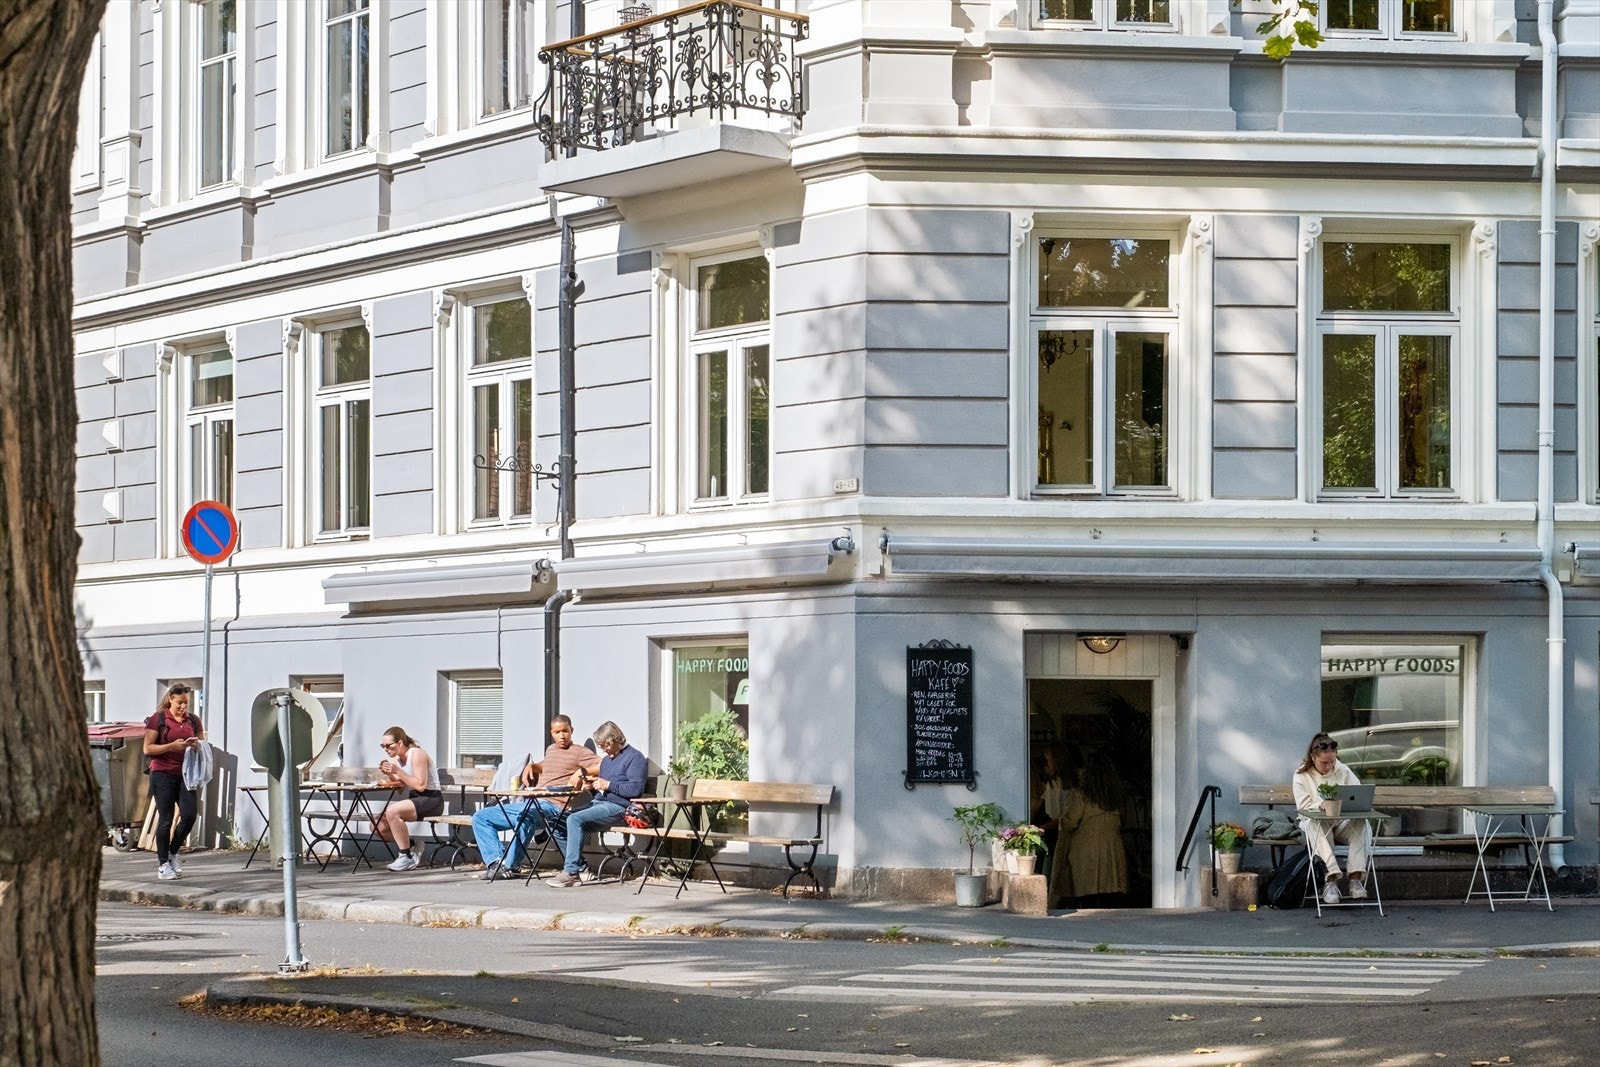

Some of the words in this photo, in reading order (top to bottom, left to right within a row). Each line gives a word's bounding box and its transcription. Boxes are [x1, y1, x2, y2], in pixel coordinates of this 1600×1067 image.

[676, 659, 713, 673] HAPPY
[911, 659, 942, 678] HAPPY
[1328, 658, 1388, 672] HAPPY
[1395, 658, 1455, 673] FOODS
